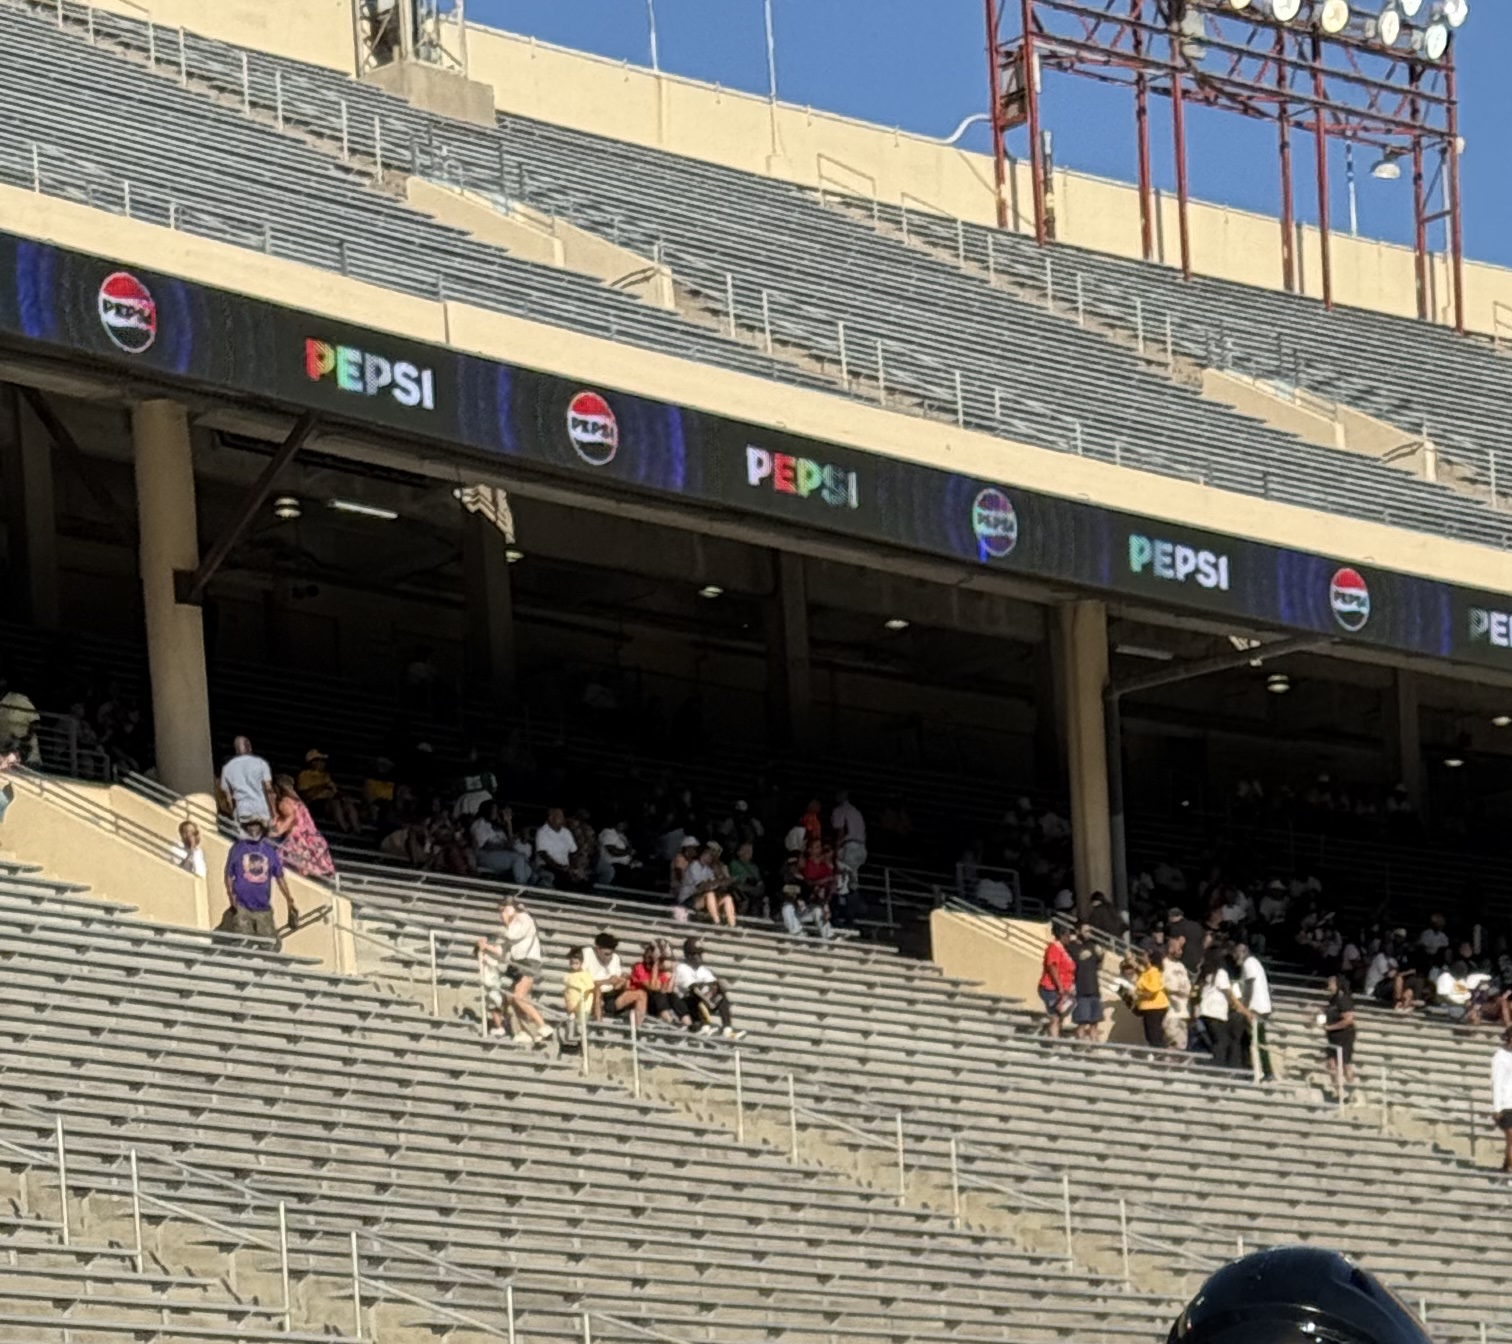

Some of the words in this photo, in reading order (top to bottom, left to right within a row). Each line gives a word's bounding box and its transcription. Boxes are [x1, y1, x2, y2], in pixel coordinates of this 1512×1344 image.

[305, 337, 436, 410] PEPSI
[571, 416, 615, 440] PEPSI
[747, 444, 859, 509] PEPSI
[1129, 534, 1229, 590] PEPSI
